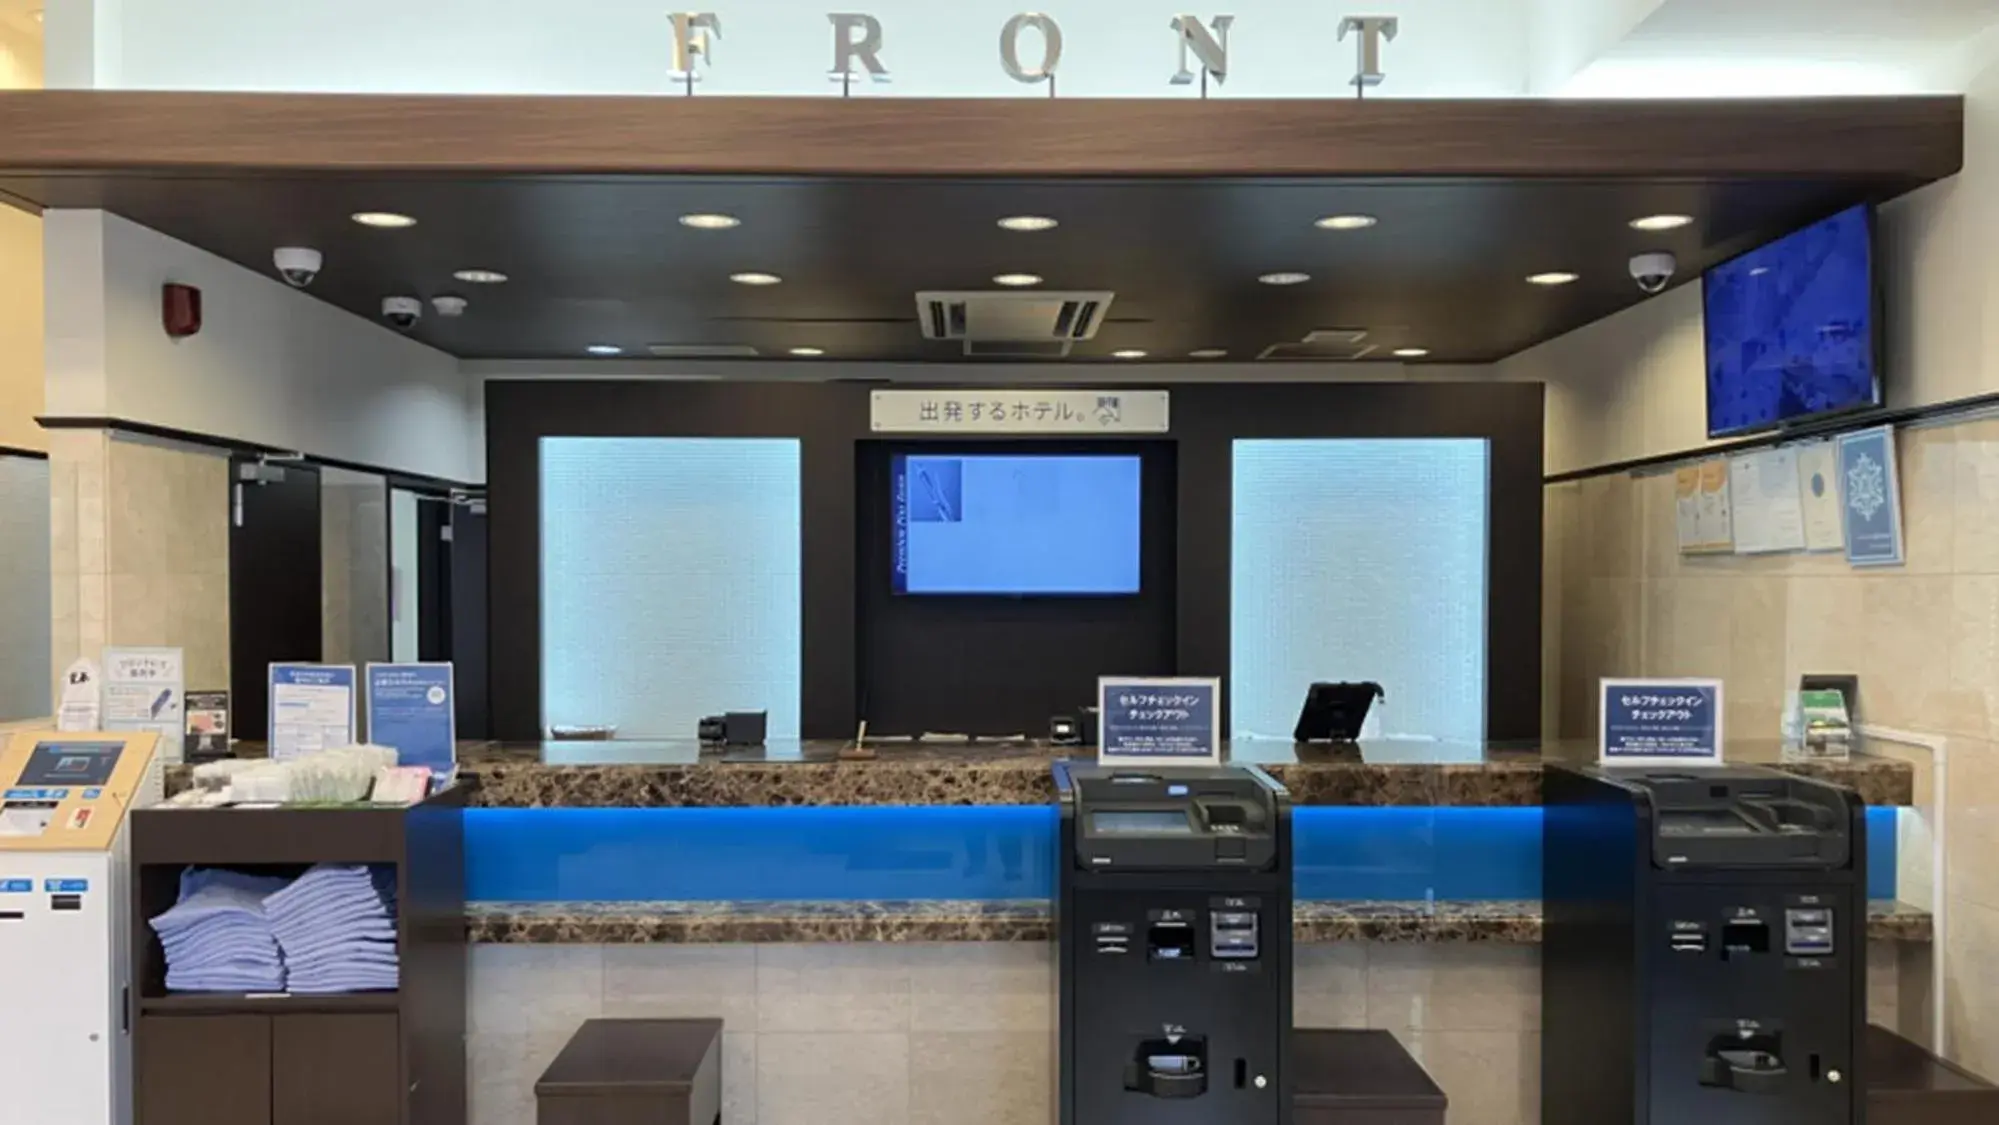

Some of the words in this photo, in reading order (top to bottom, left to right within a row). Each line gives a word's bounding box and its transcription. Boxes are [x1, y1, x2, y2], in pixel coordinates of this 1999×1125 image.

[667, 12, 1399, 85] FRONT
[919, 400, 1086, 422] 出発するホテル。
[1120, 695, 1200, 706] セルフチェックイン
[1621, 694, 1702, 706] セルフチェックイン
[1631, 709, 1693, 720] チェックアウト
